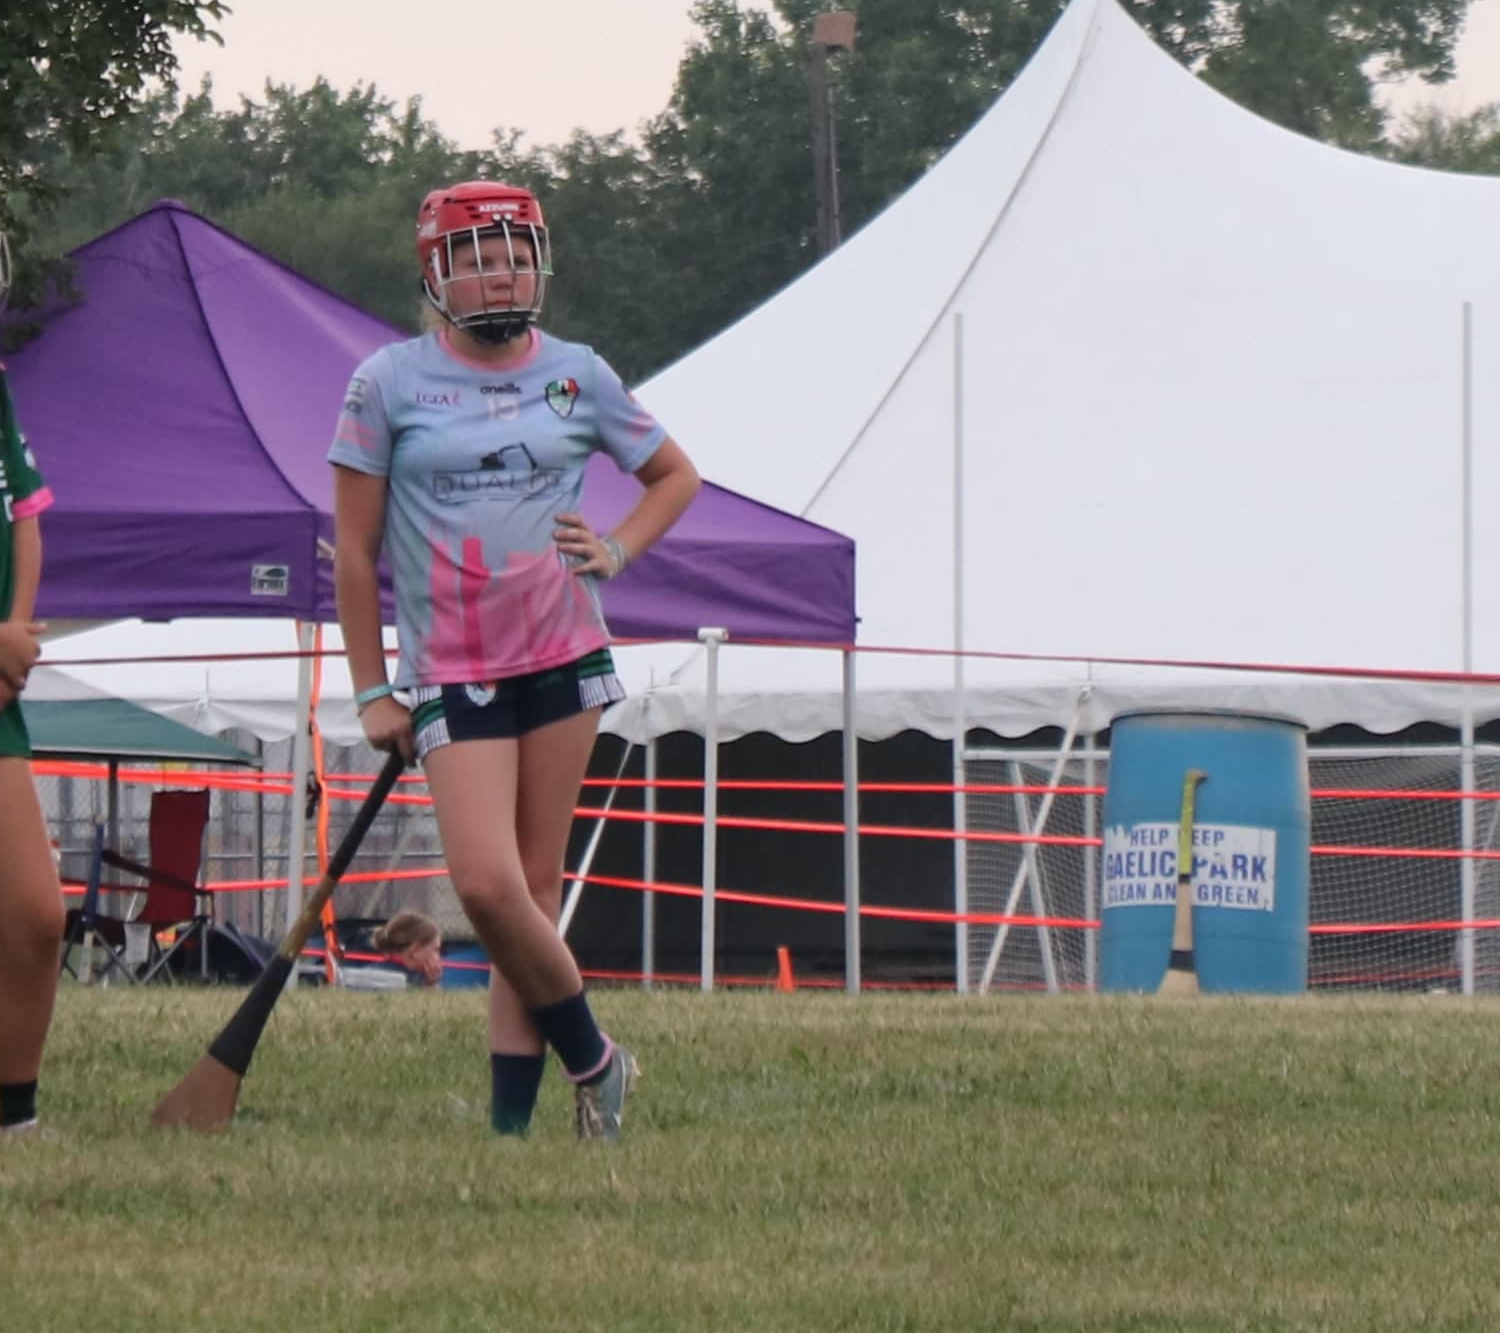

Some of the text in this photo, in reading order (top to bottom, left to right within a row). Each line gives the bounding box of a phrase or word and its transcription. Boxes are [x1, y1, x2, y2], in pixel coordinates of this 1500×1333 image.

[1129, 829, 1225, 846] HELP EEP
[1106, 851, 1268, 883] GAELIC PARK
[1107, 884, 1259, 905] CLEAN AN GREEN
